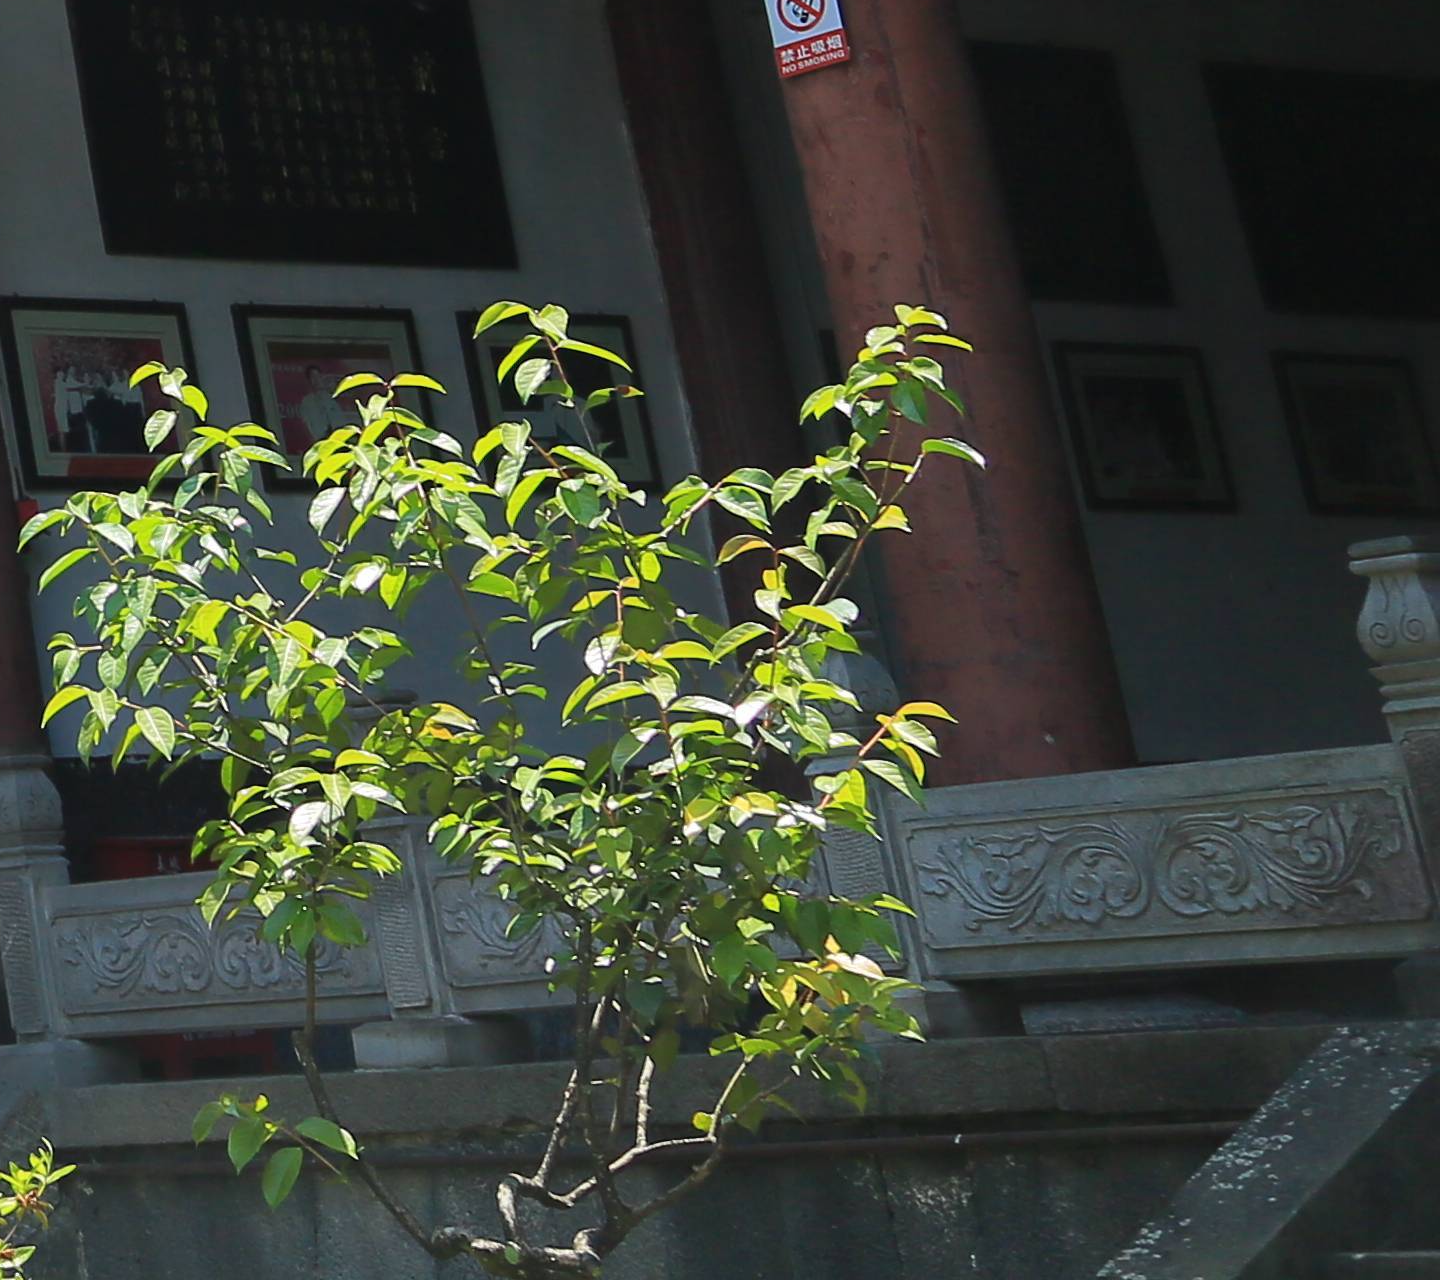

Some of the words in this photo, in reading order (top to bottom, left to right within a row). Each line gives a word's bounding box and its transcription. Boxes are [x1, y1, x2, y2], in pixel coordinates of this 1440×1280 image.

[780, 34, 842, 64] 禁止吸烟
[782, 64, 797, 74] NO
[798, 50, 845, 70] SMOKING
